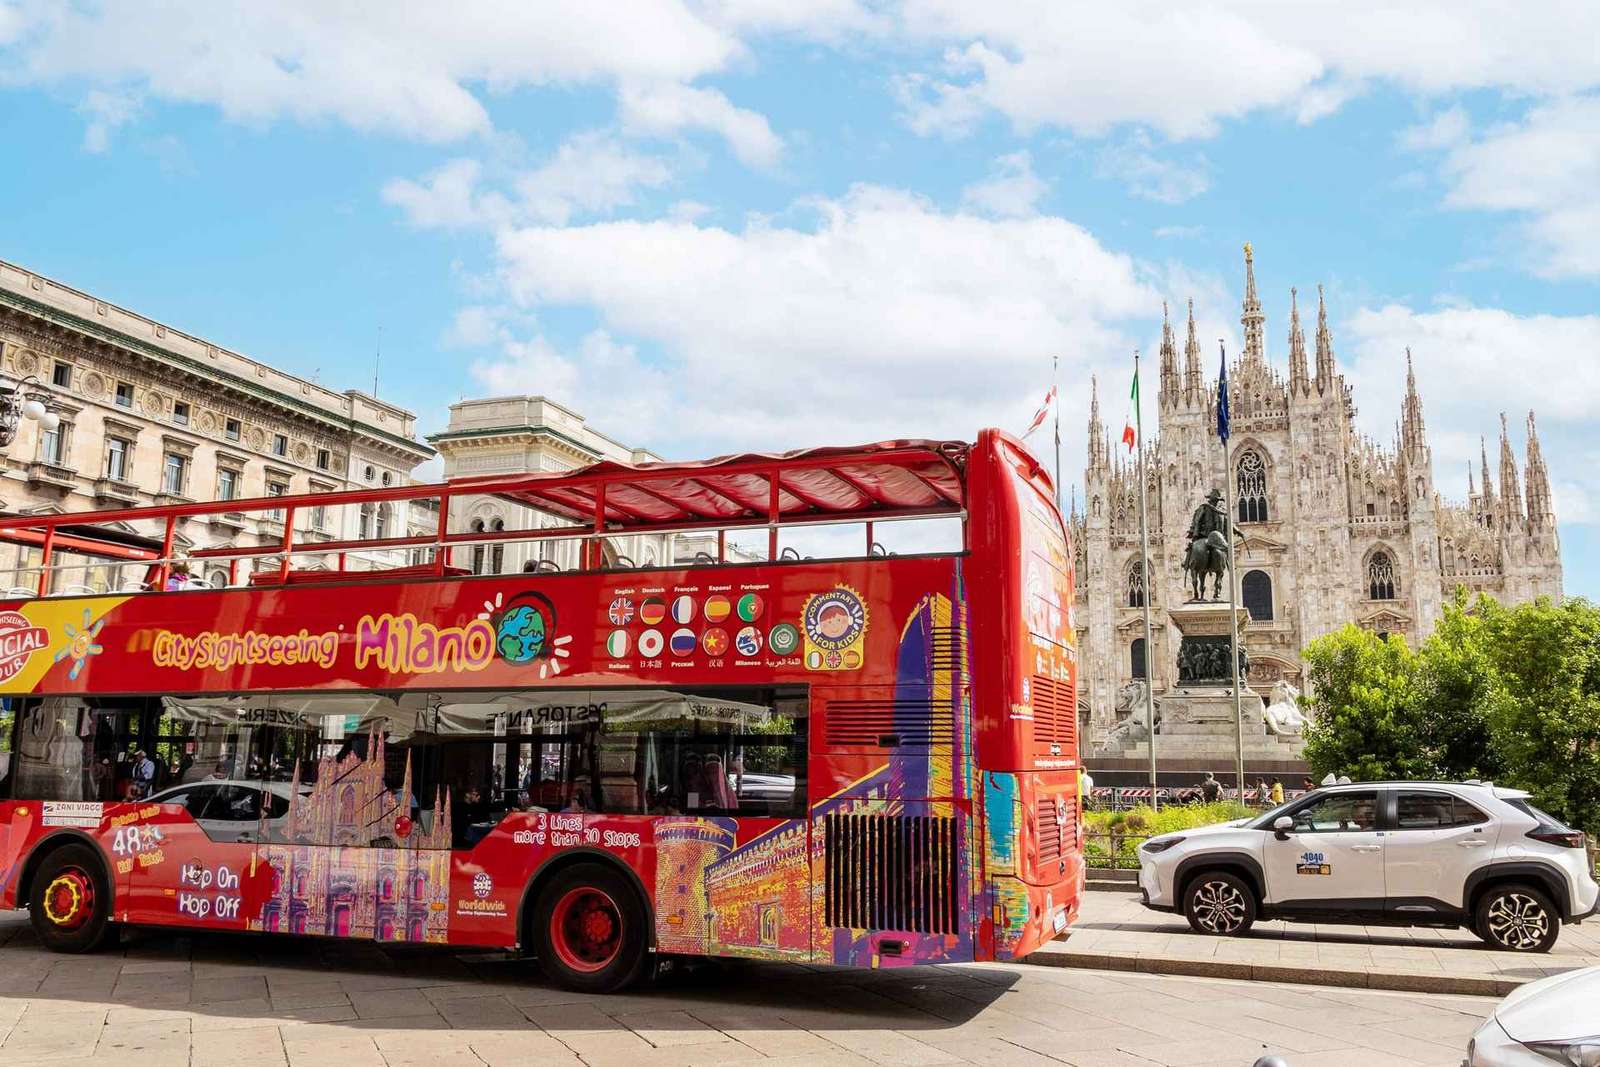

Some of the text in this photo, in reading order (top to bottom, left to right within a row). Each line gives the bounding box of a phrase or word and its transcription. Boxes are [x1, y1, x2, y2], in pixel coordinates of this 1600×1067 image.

[807, 592, 855, 617] COMMENTARY
[153, 612, 497, 673] CitySightseeing Milano
[816, 629, 859, 649] FOR KIDS
[538, 813, 583, 831] 3 Lines
[112, 826, 141, 856] 48
[513, 828, 640, 848] more than 30 Stops
[182, 864, 239, 889] Hop On
[180, 893, 241, 918] Hop Off
